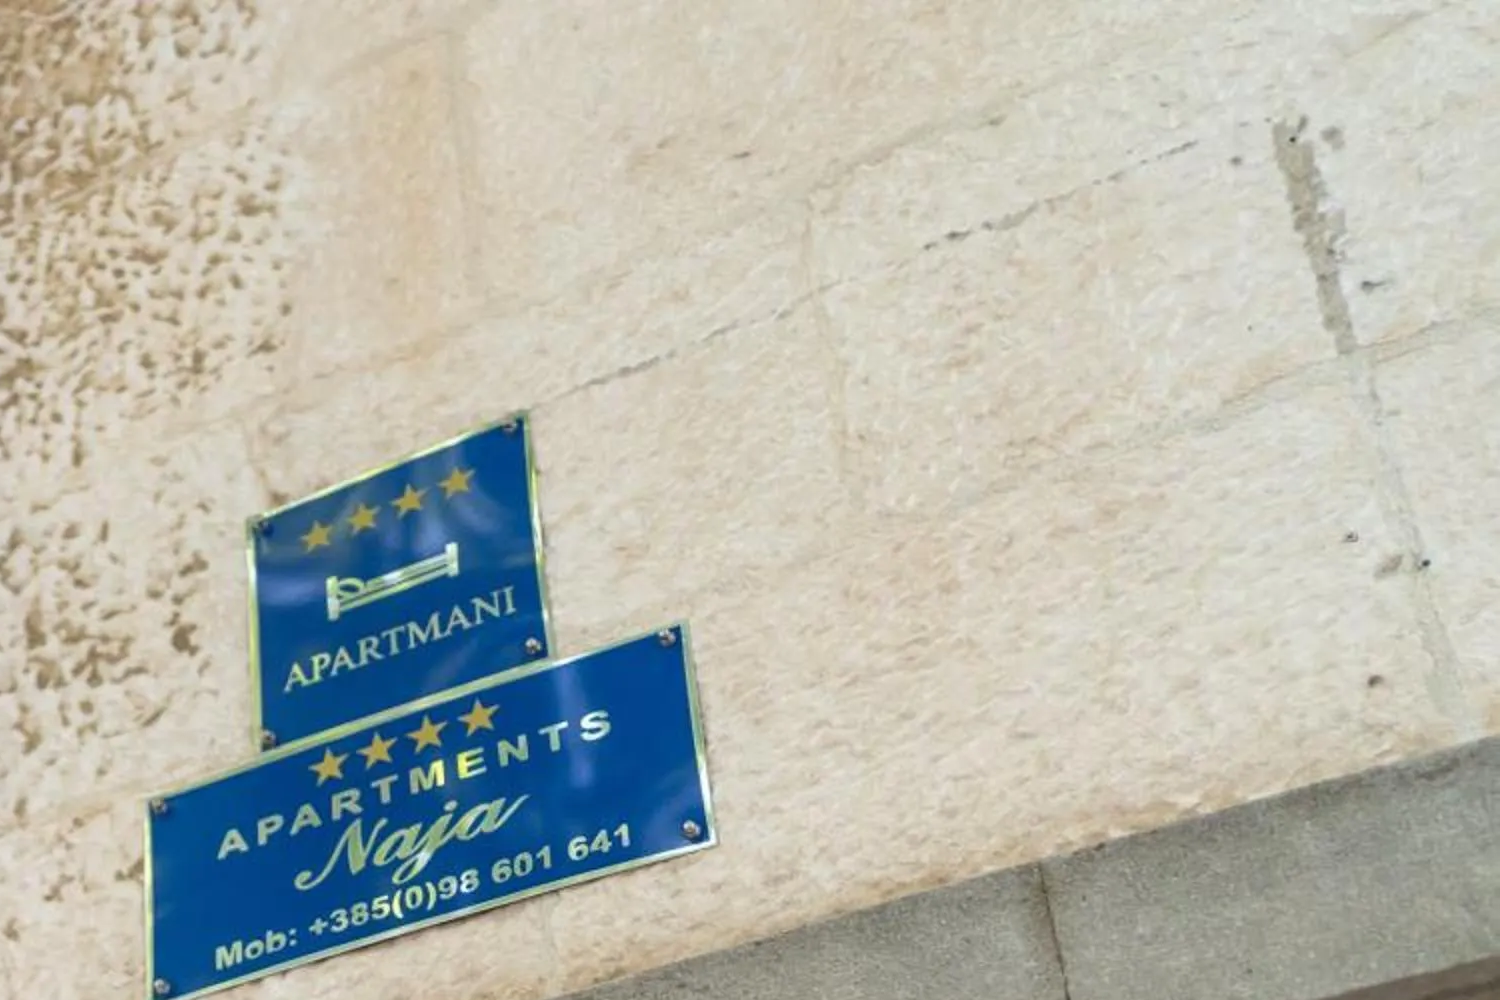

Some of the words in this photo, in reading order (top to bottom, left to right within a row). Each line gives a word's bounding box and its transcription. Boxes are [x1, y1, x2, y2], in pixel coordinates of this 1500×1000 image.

[283, 586, 516, 692] APARTMANI
[217, 710, 612, 860] APARTMENTS
[294, 793, 530, 890] Naja
[214, 928, 297, 970] Mob:
[308, 868, 480, 935] +385(0)98
[491, 844, 553, 883] 601
[567, 823, 632, 861] 641
